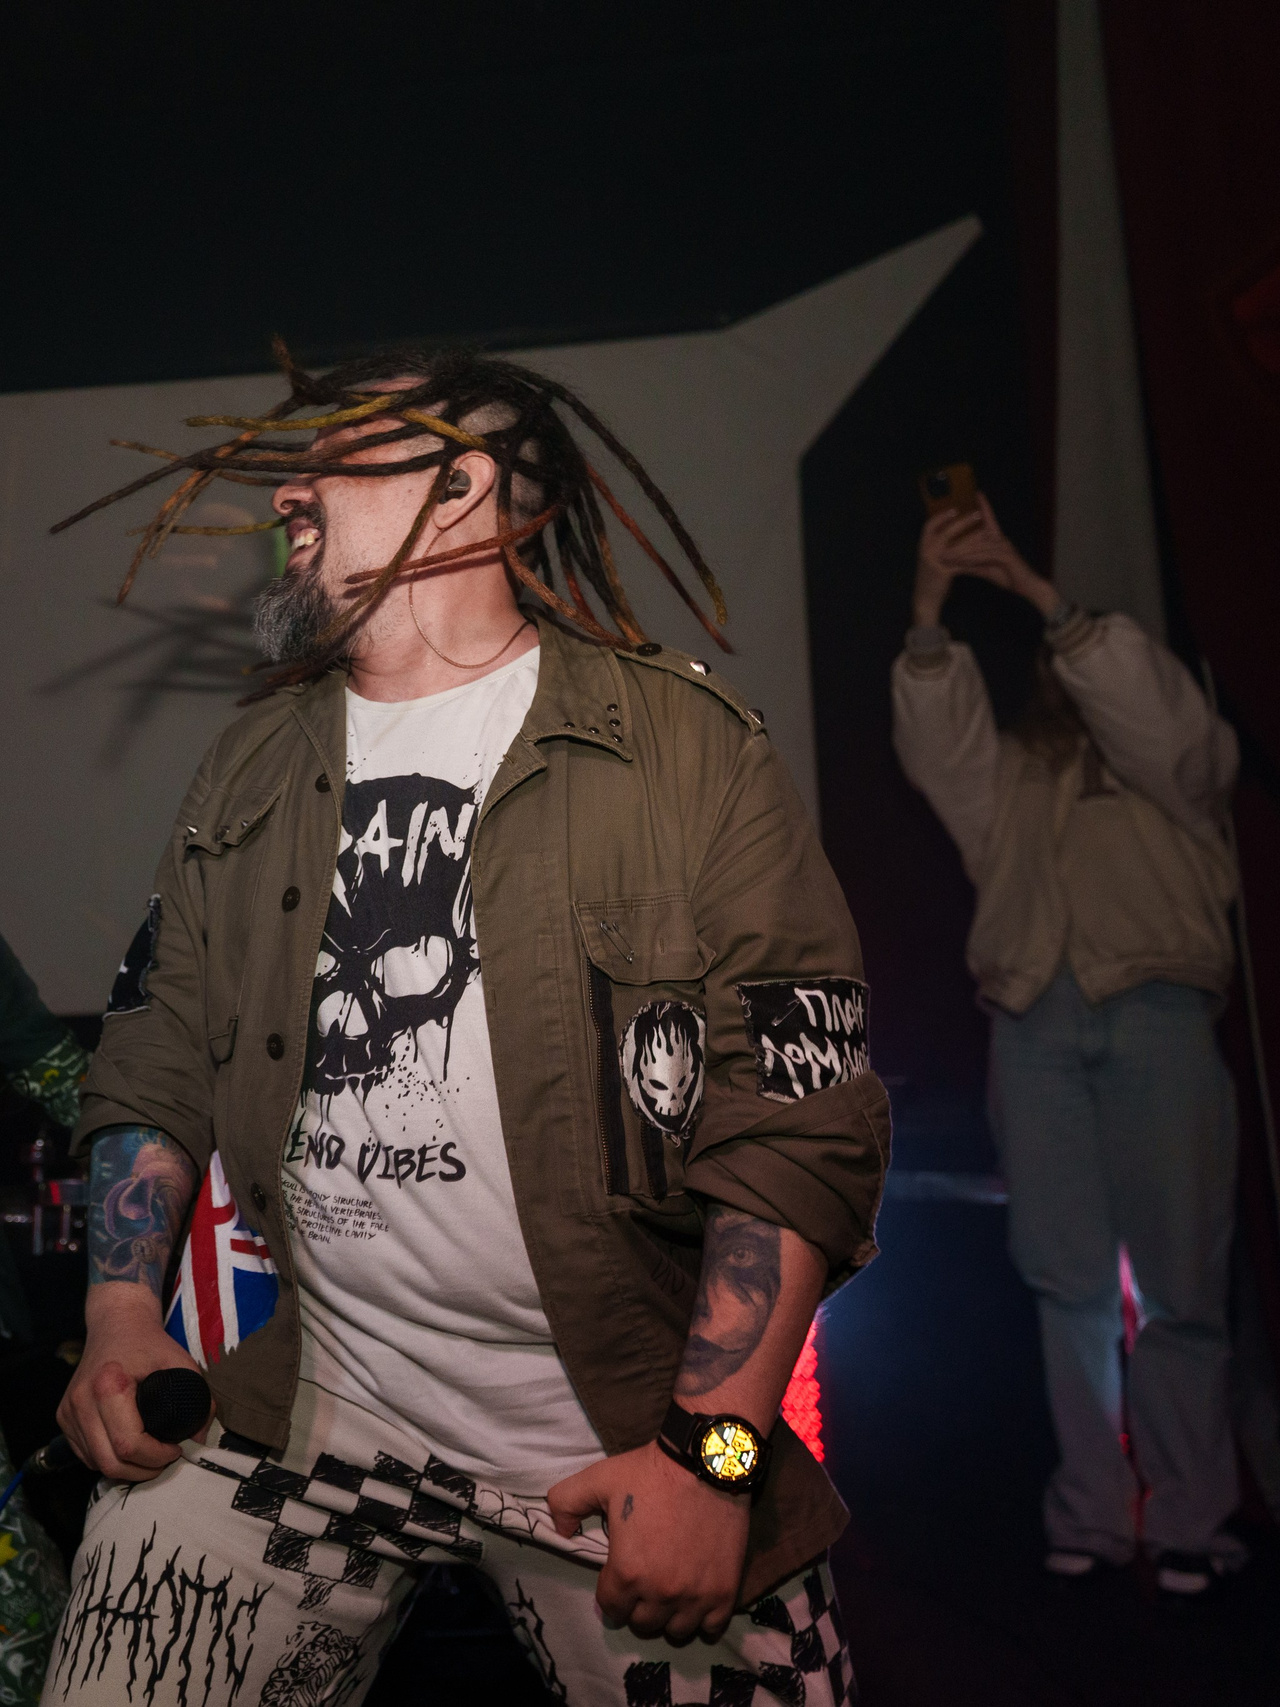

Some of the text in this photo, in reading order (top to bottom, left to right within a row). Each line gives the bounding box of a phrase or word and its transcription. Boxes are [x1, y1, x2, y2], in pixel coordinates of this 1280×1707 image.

[282, 1110, 466, 1189] END VIBES
[333, 1195, 373, 1209] STRUCTURE
[337, 1217, 349, 1226] OF
[370, 1222, 389, 1232] FACE
[345, 1229, 376, 1240] CAVITY
